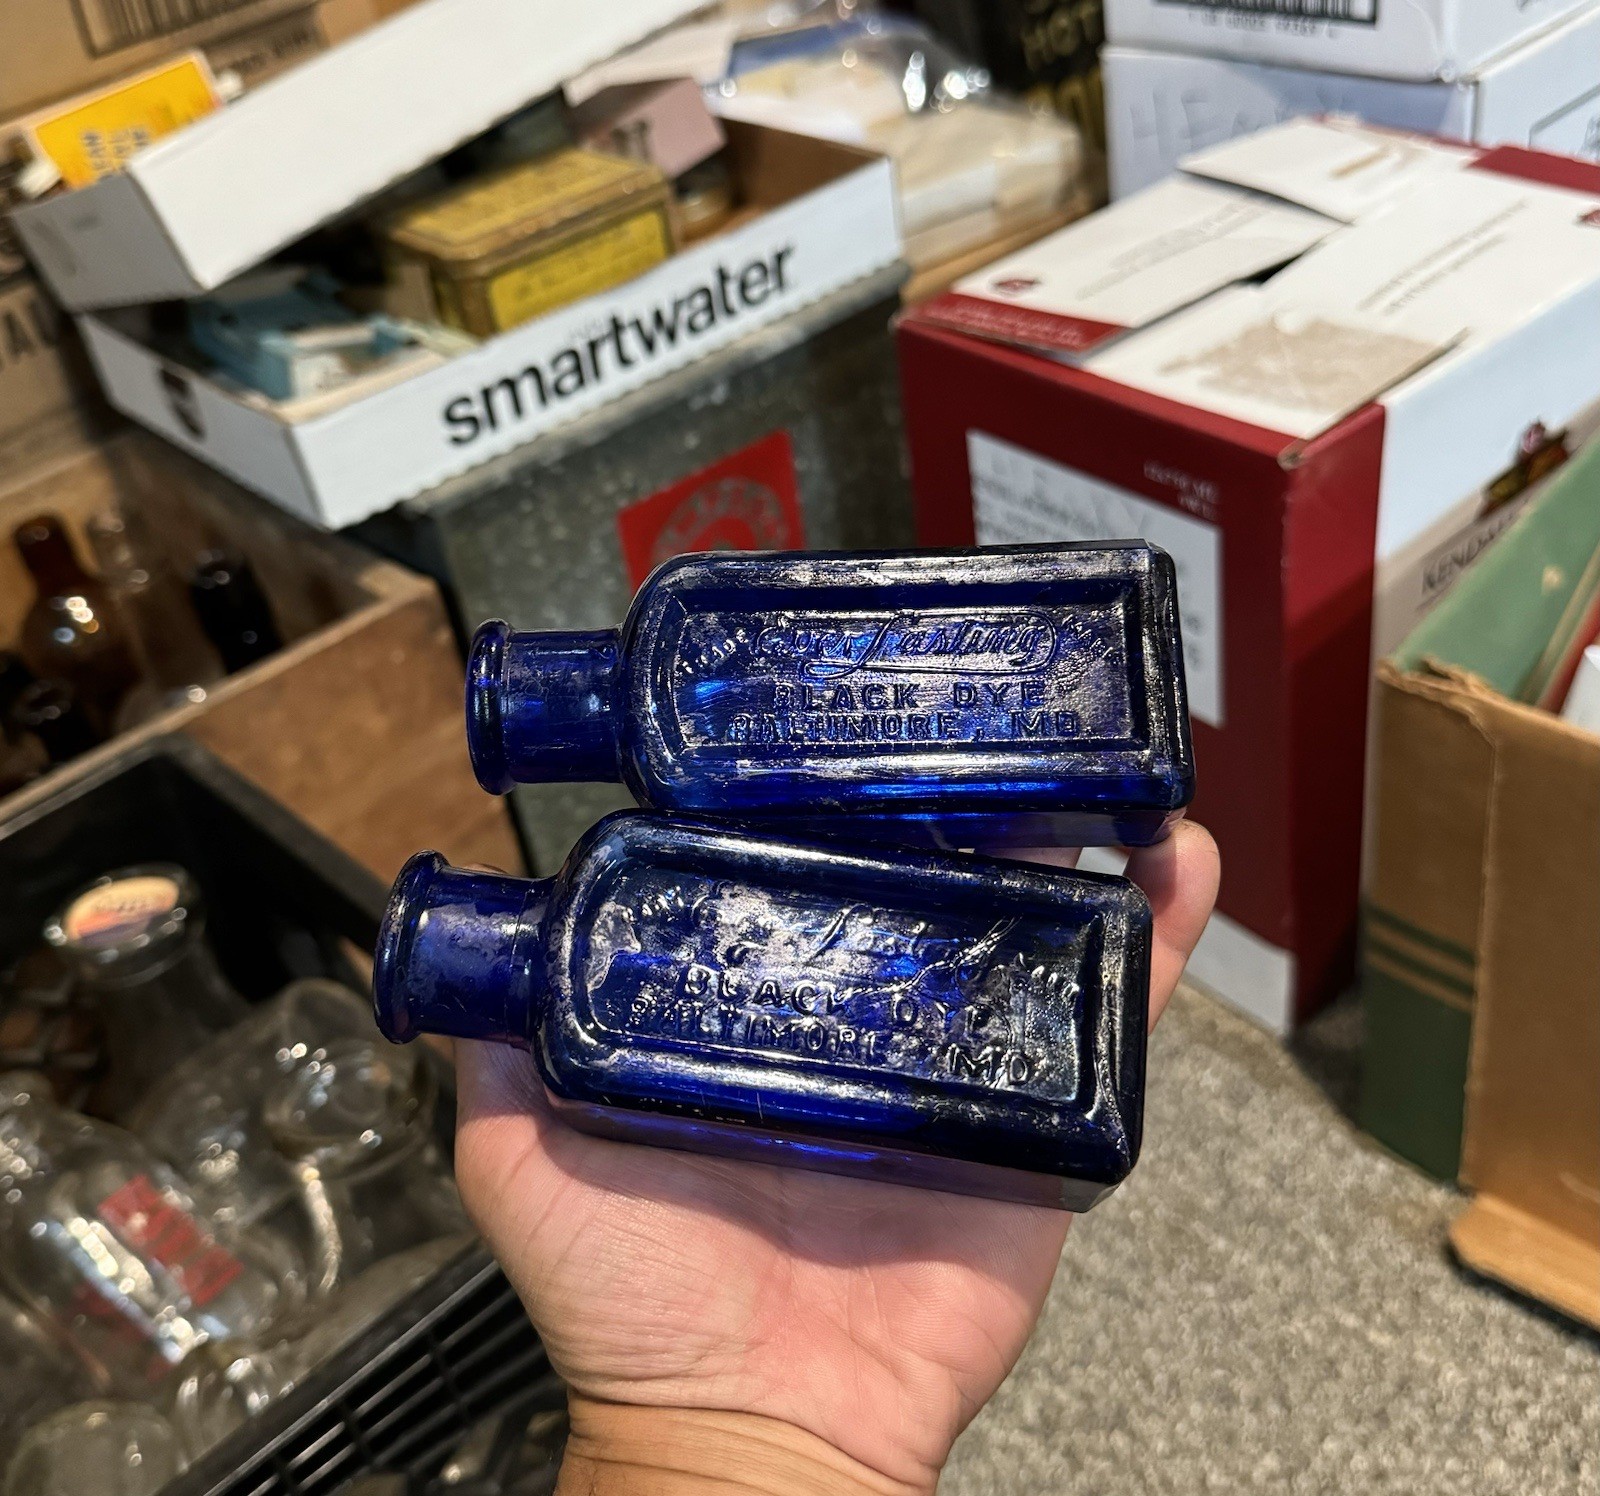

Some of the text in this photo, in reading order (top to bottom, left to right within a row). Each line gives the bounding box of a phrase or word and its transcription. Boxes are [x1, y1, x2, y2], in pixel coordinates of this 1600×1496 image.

[443, 242, 796, 447] smartwater
[772, 679, 1046, 710] BLACK DYE
